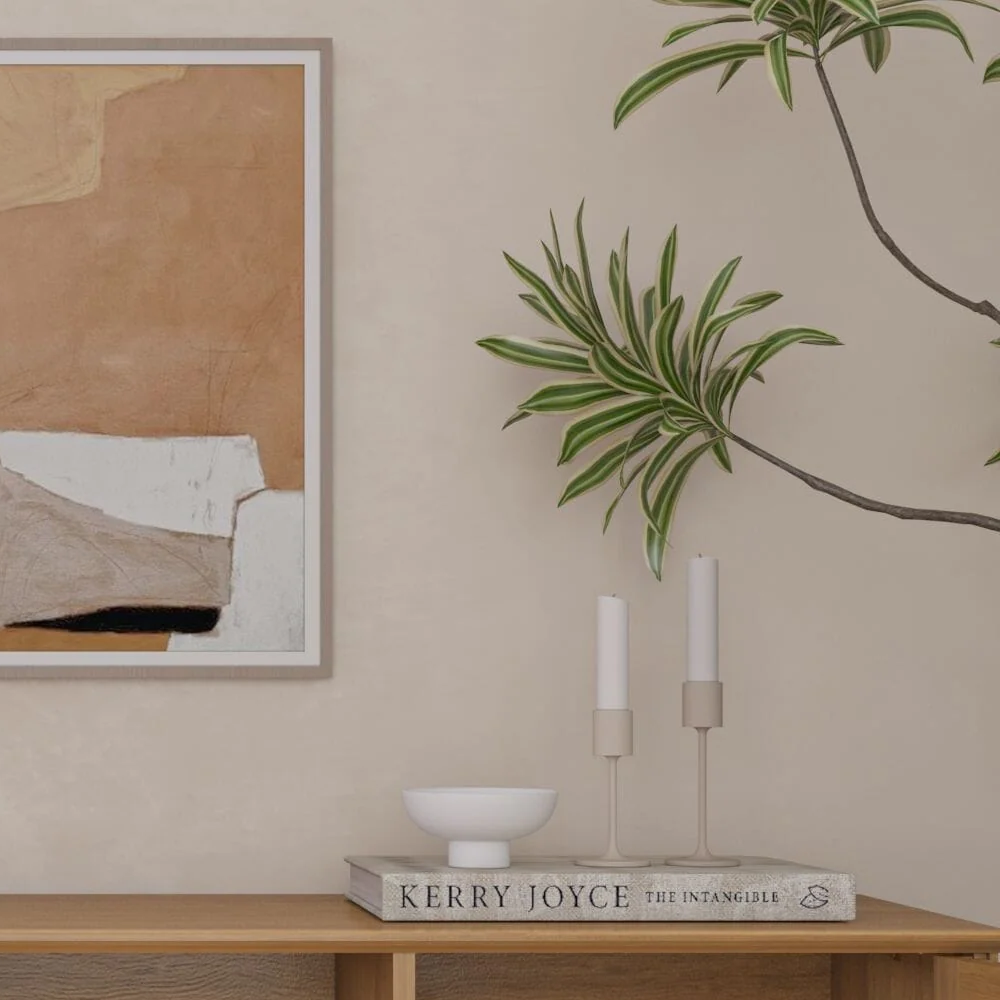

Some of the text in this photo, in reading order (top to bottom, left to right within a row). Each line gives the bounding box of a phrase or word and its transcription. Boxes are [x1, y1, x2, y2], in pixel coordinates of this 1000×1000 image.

[400, 885, 779, 912] KERRY JOYCE THE INTANGIBLE
